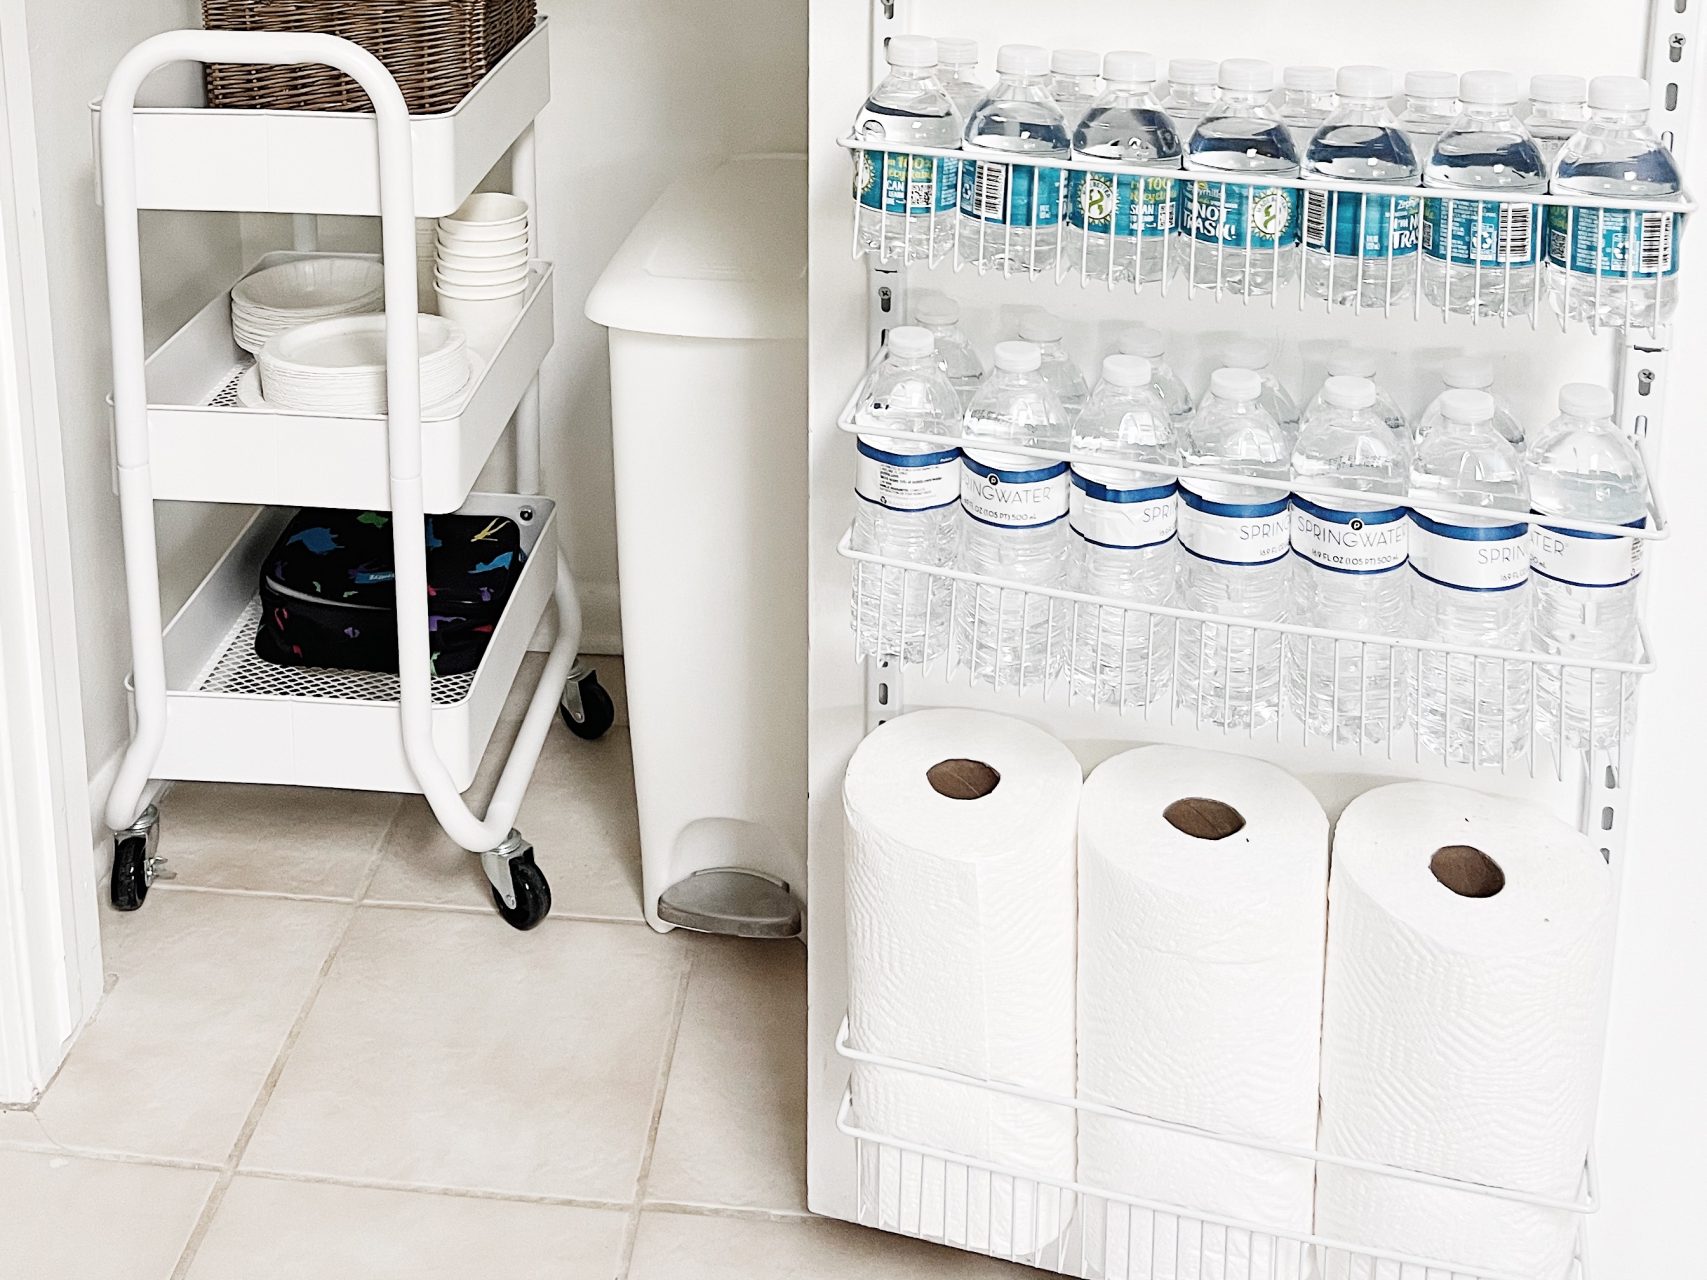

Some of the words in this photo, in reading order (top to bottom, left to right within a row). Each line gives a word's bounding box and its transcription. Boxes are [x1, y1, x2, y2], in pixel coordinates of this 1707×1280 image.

[886, 180, 904, 192] CAN
[1197, 200, 1233, 222] NOT
[974, 504, 984, 515] OZ
[1010, 513, 1028, 521] 500
[1142, 503, 1175, 523] SPRI
[1240, 520, 1291, 541] SPRIN
[1322, 552, 1332, 562] FL
[1333, 555, 1345, 565] OZ
[1364, 557, 1376, 566] PT)
[1377, 555, 1393, 565] 500
[1477, 545, 1528, 565] SPRIN
